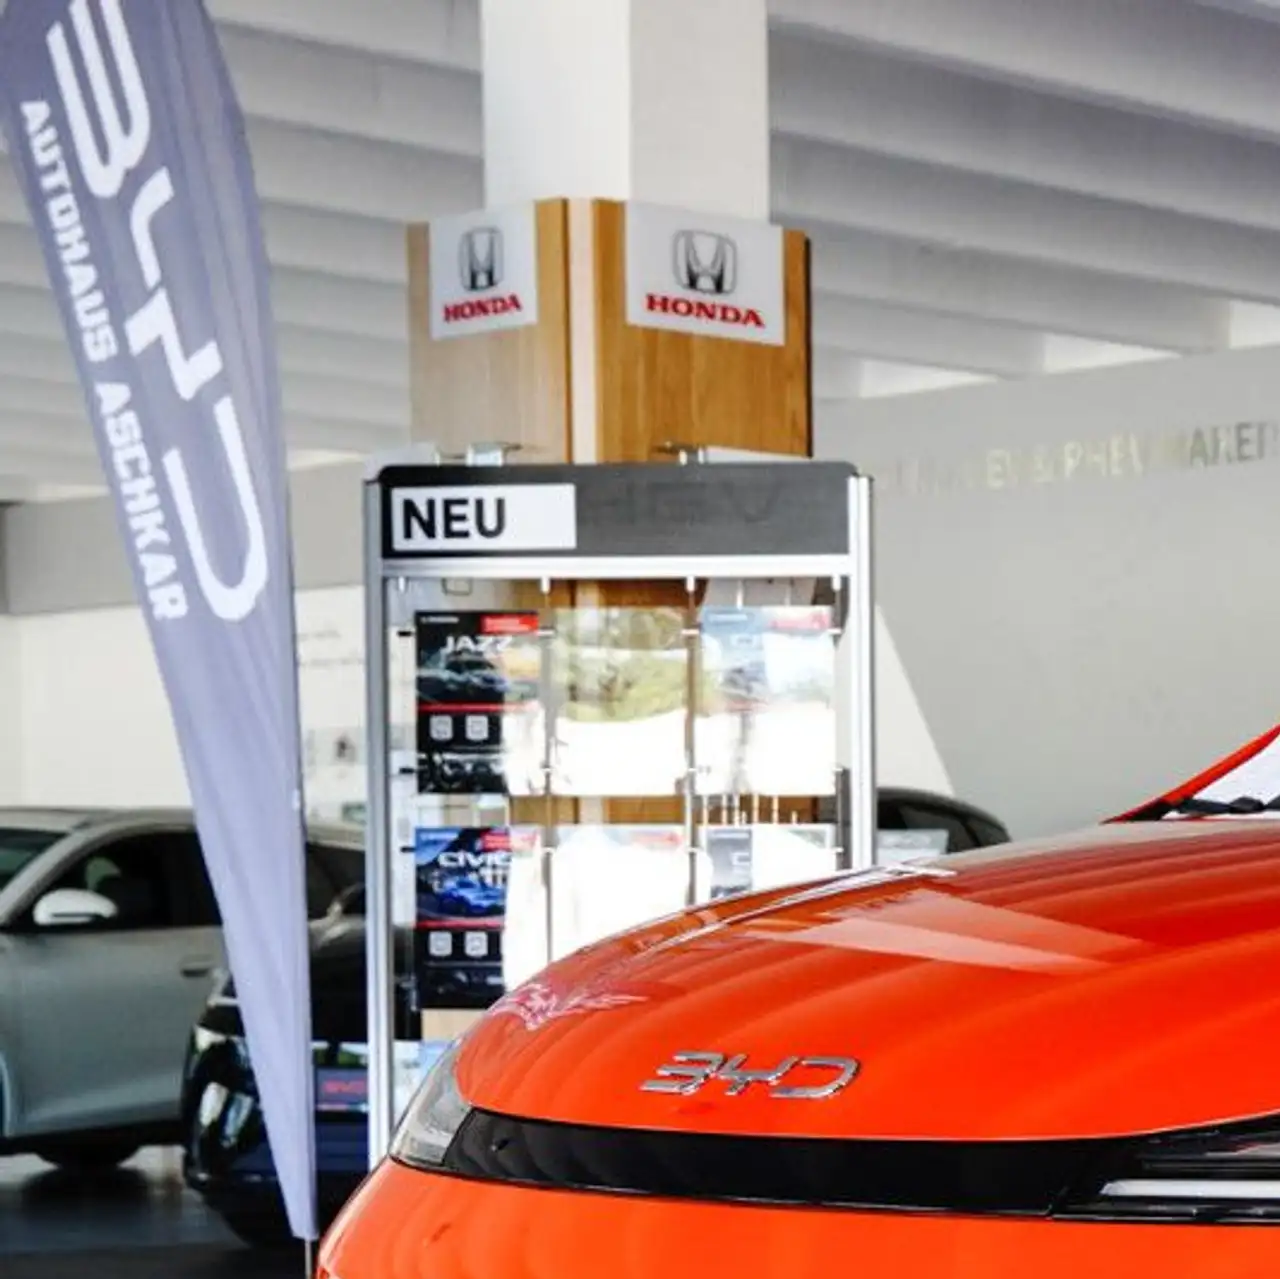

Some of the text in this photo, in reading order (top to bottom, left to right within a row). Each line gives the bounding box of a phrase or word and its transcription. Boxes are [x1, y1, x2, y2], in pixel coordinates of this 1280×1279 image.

[443, 294, 522, 323] HONDA
[645, 294, 764, 328] HONDA
[20, 100, 188, 620] AUTOHAUS ASCHKAR
[403, 498, 505, 539] NEU
[445, 635, 513, 652] JAZZ
[437, 851, 513, 868] CIVIC
[641, 1049, 861, 1101] BYD
